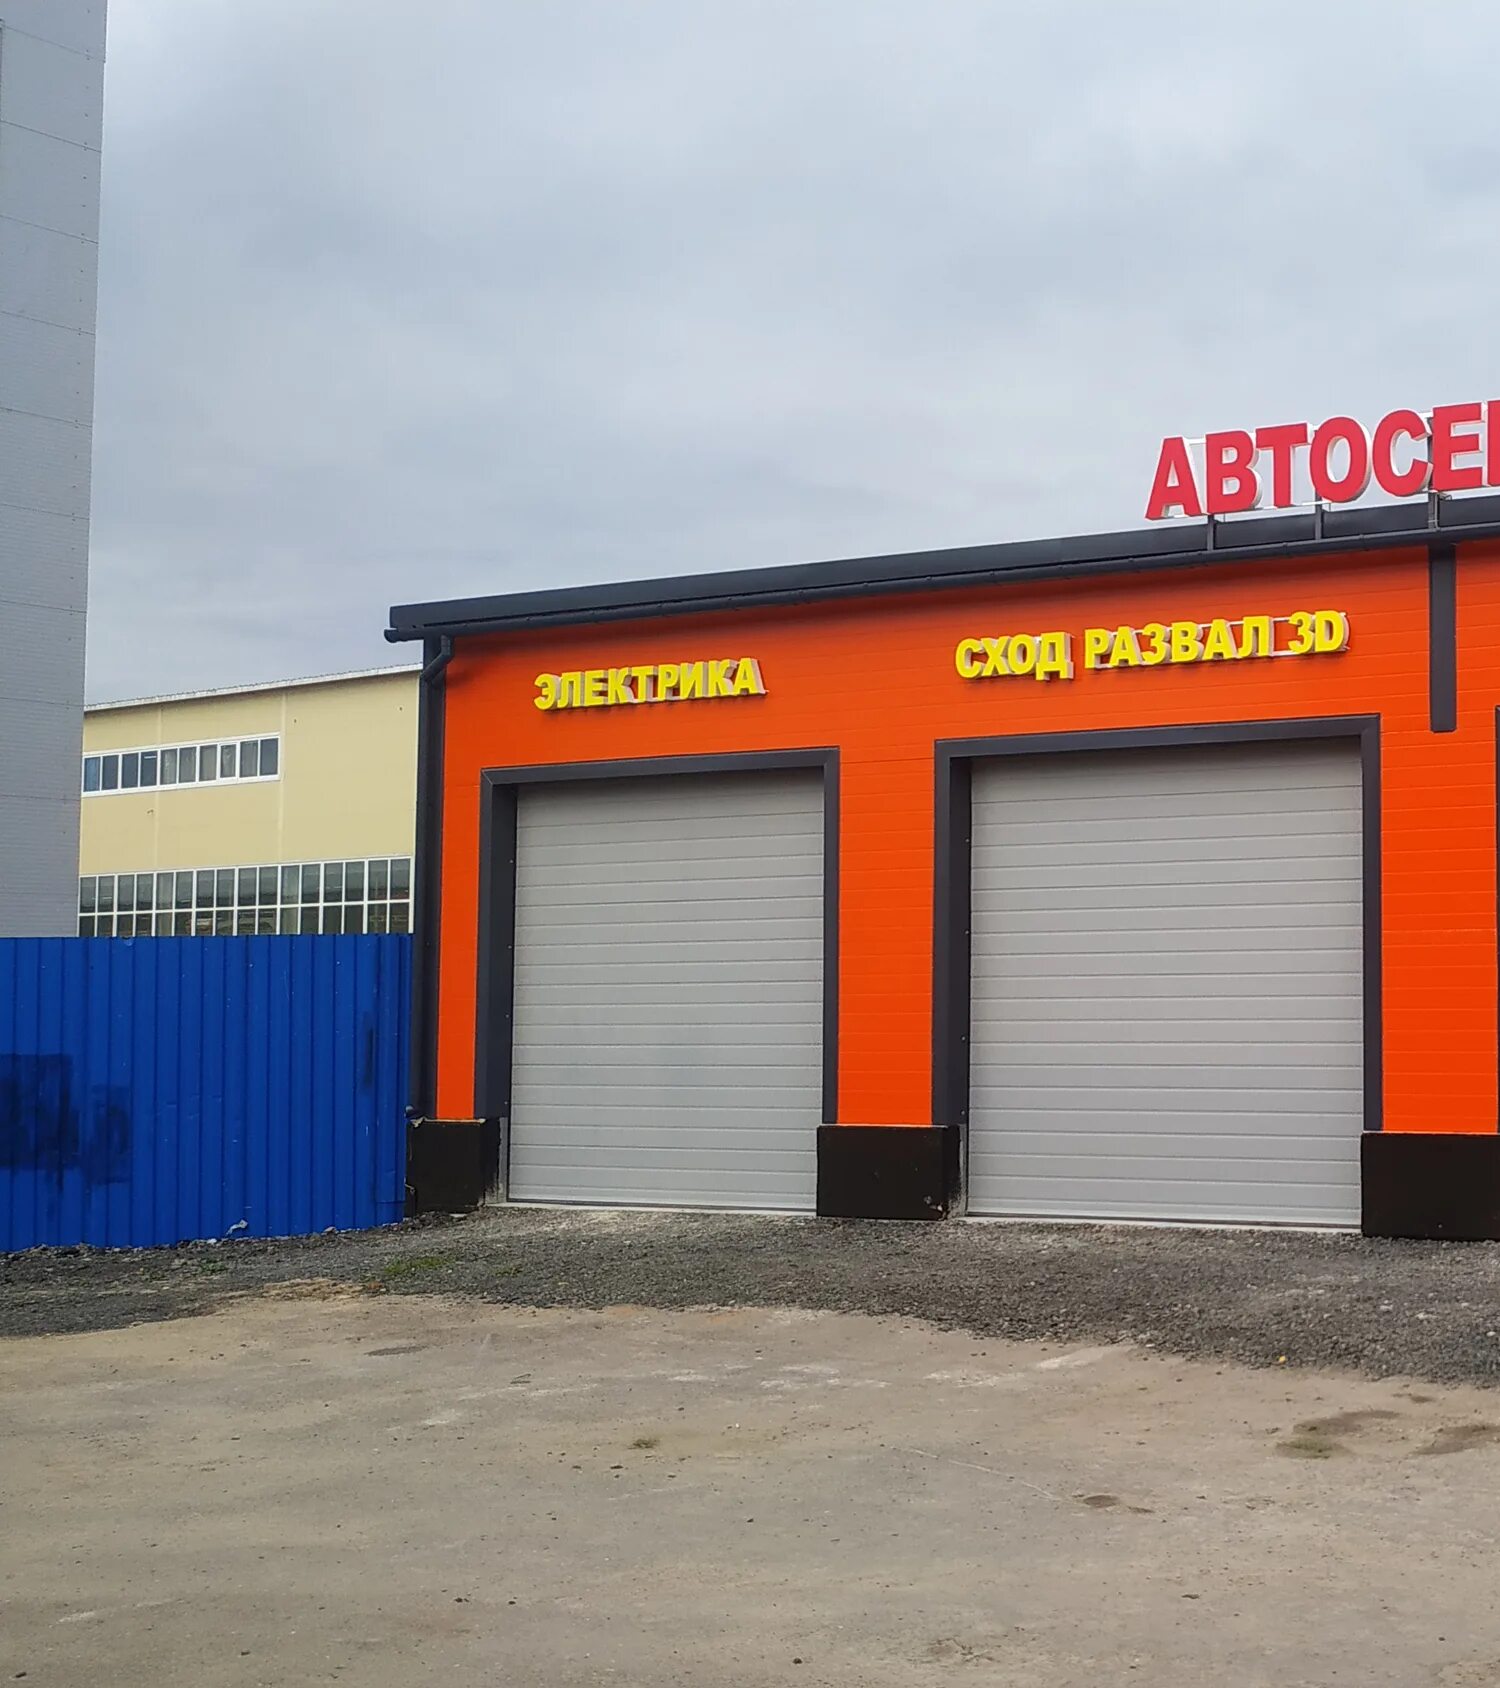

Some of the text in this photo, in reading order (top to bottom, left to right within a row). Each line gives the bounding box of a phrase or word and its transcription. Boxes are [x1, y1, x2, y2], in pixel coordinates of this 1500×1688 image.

[956, 610, 1348, 680] СХОД РАЗВАЛ 3D
[535, 658, 763, 711] ЭЛЕКТРИКА
